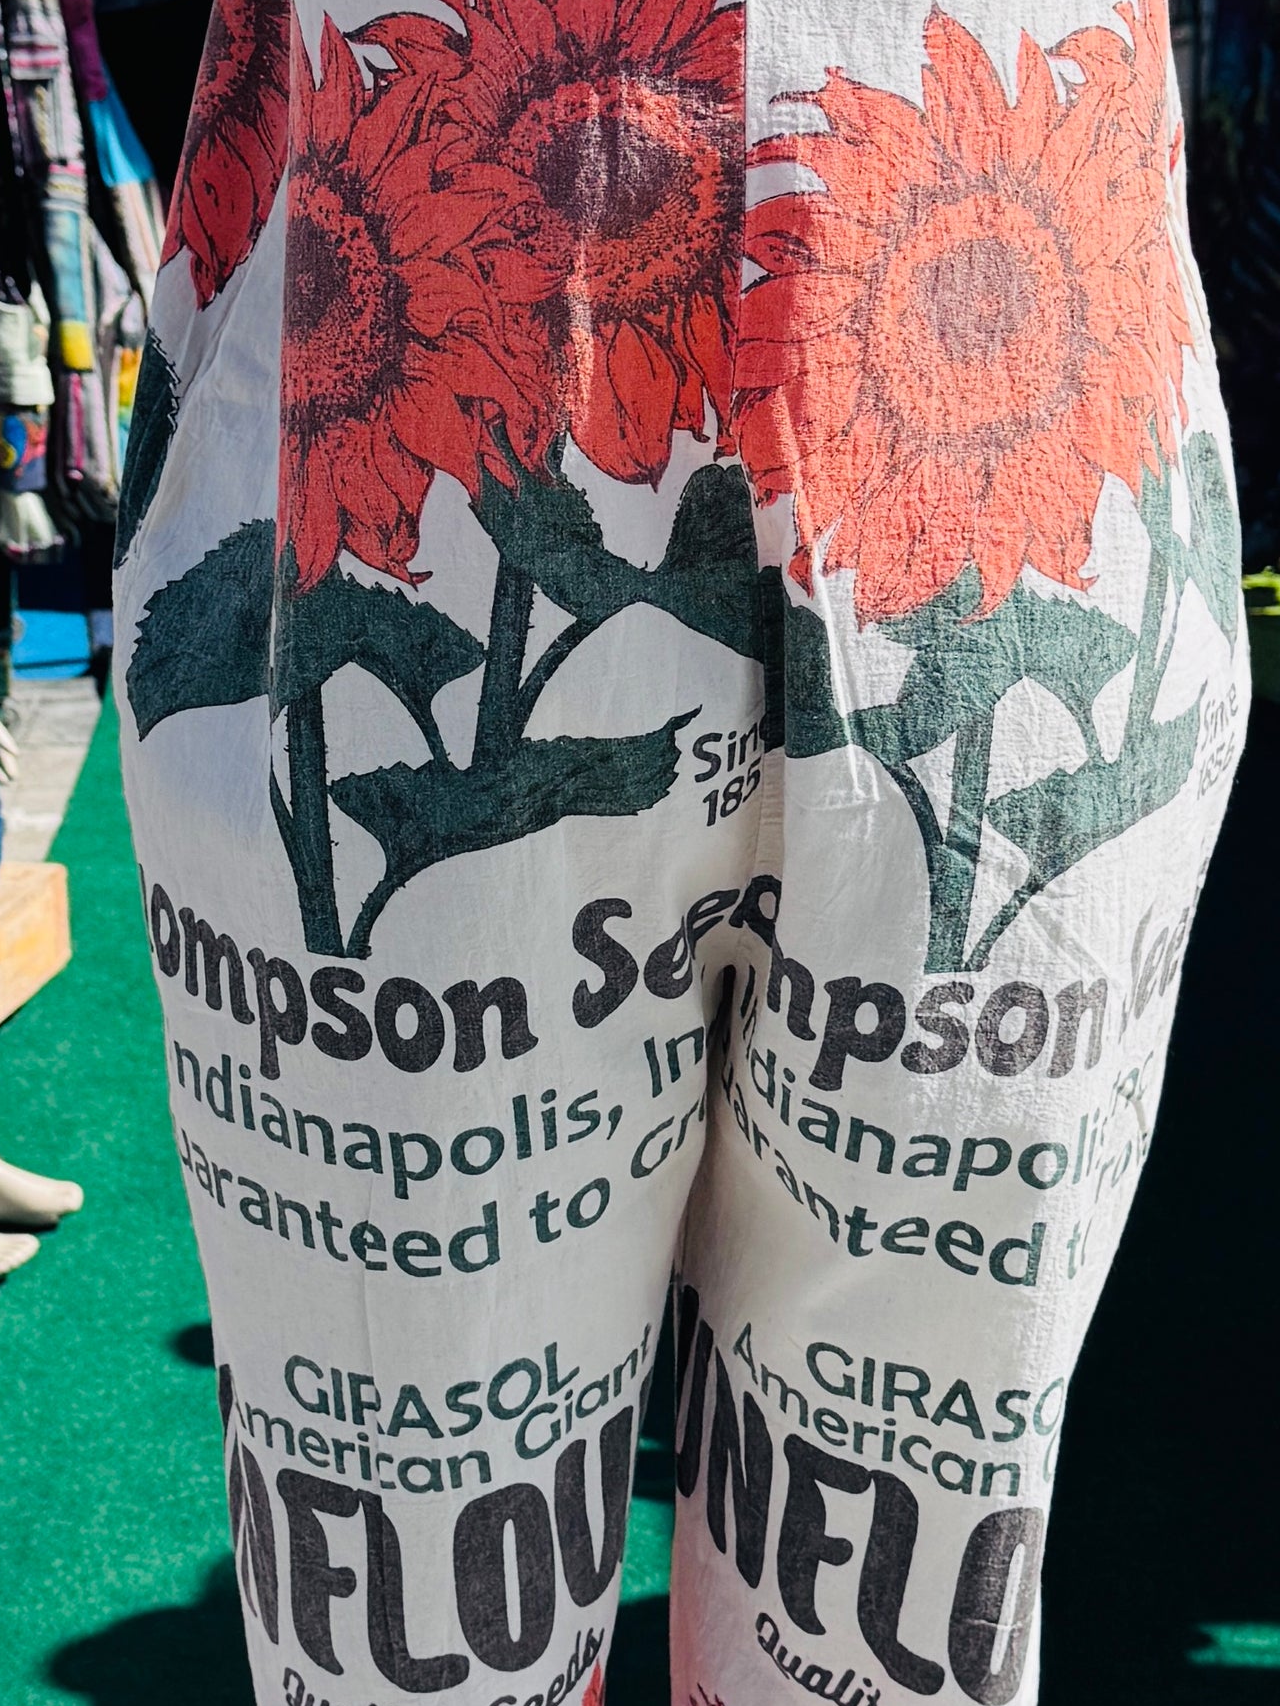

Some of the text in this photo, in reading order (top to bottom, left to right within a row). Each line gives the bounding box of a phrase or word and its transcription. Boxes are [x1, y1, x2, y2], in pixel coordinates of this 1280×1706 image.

[703, 756, 762, 827] 185
[140, 865, 539, 1080] ompson
[528, 1177, 611, 1244] to
[284, 1341, 579, 1440] GIRASOL
[514, 1323, 654, 1460] Giant
[733, 1321, 1021, 1497] American
